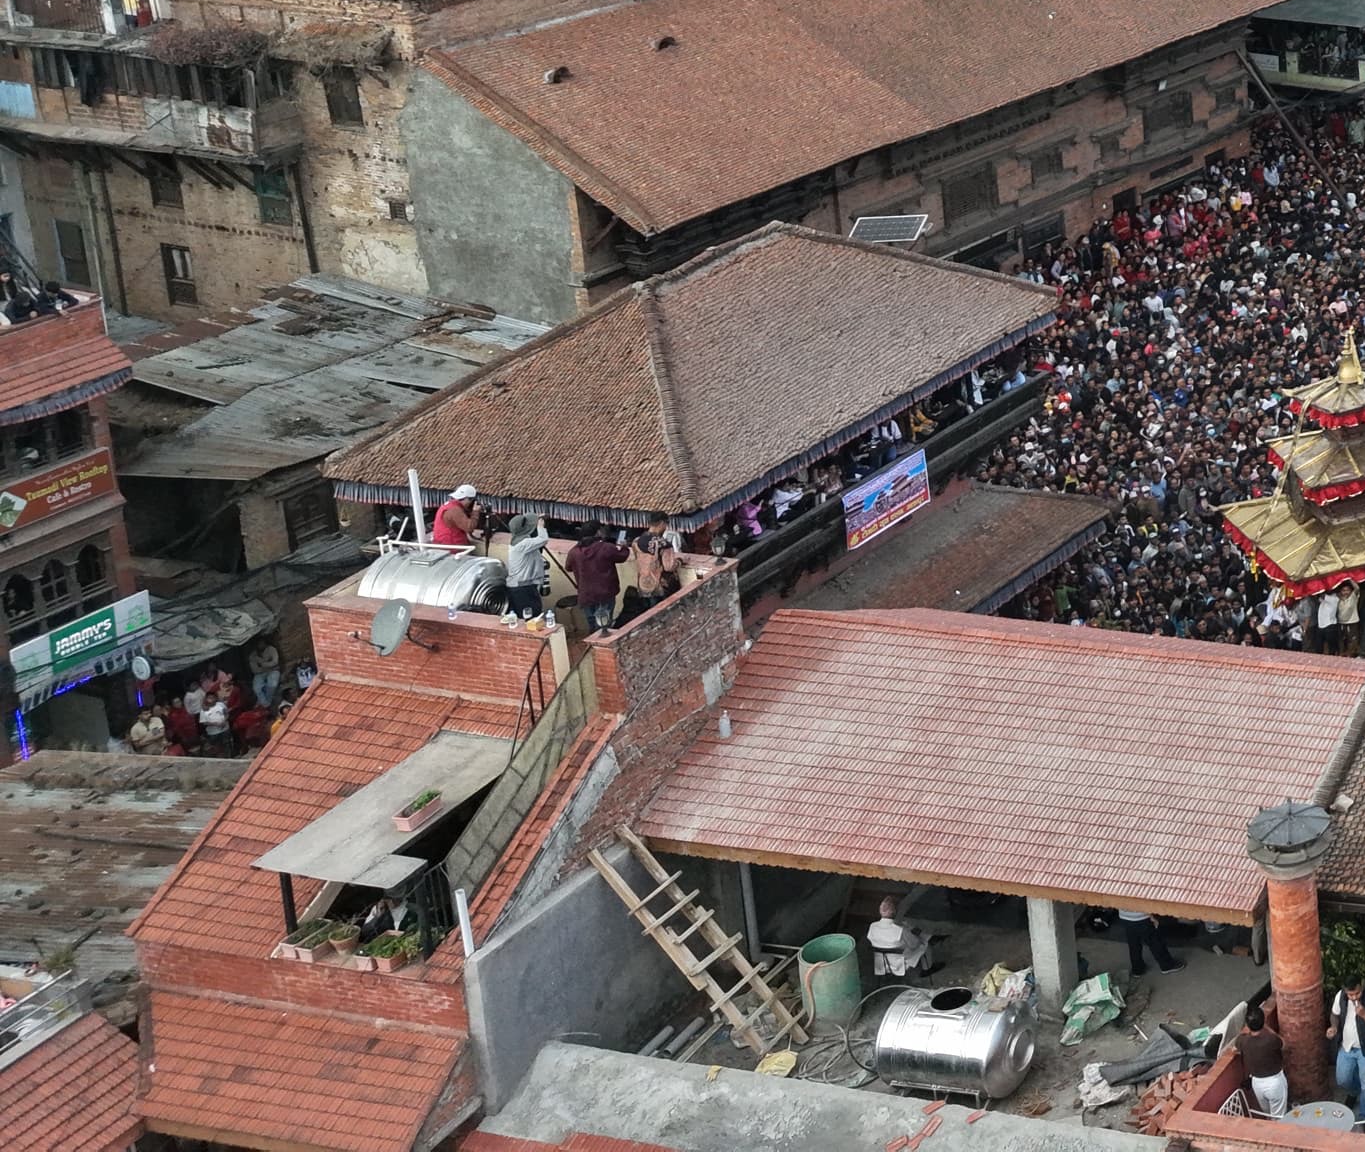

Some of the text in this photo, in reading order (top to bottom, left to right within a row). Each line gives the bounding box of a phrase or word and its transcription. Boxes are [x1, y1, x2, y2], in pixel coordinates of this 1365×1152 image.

[60, 475, 79, 488] View
[79, 464, 109, 481] Rooftop
[54, 618, 112, 655] JAMMY'S
[60, 631, 108, 656] BUBBLE TEA
